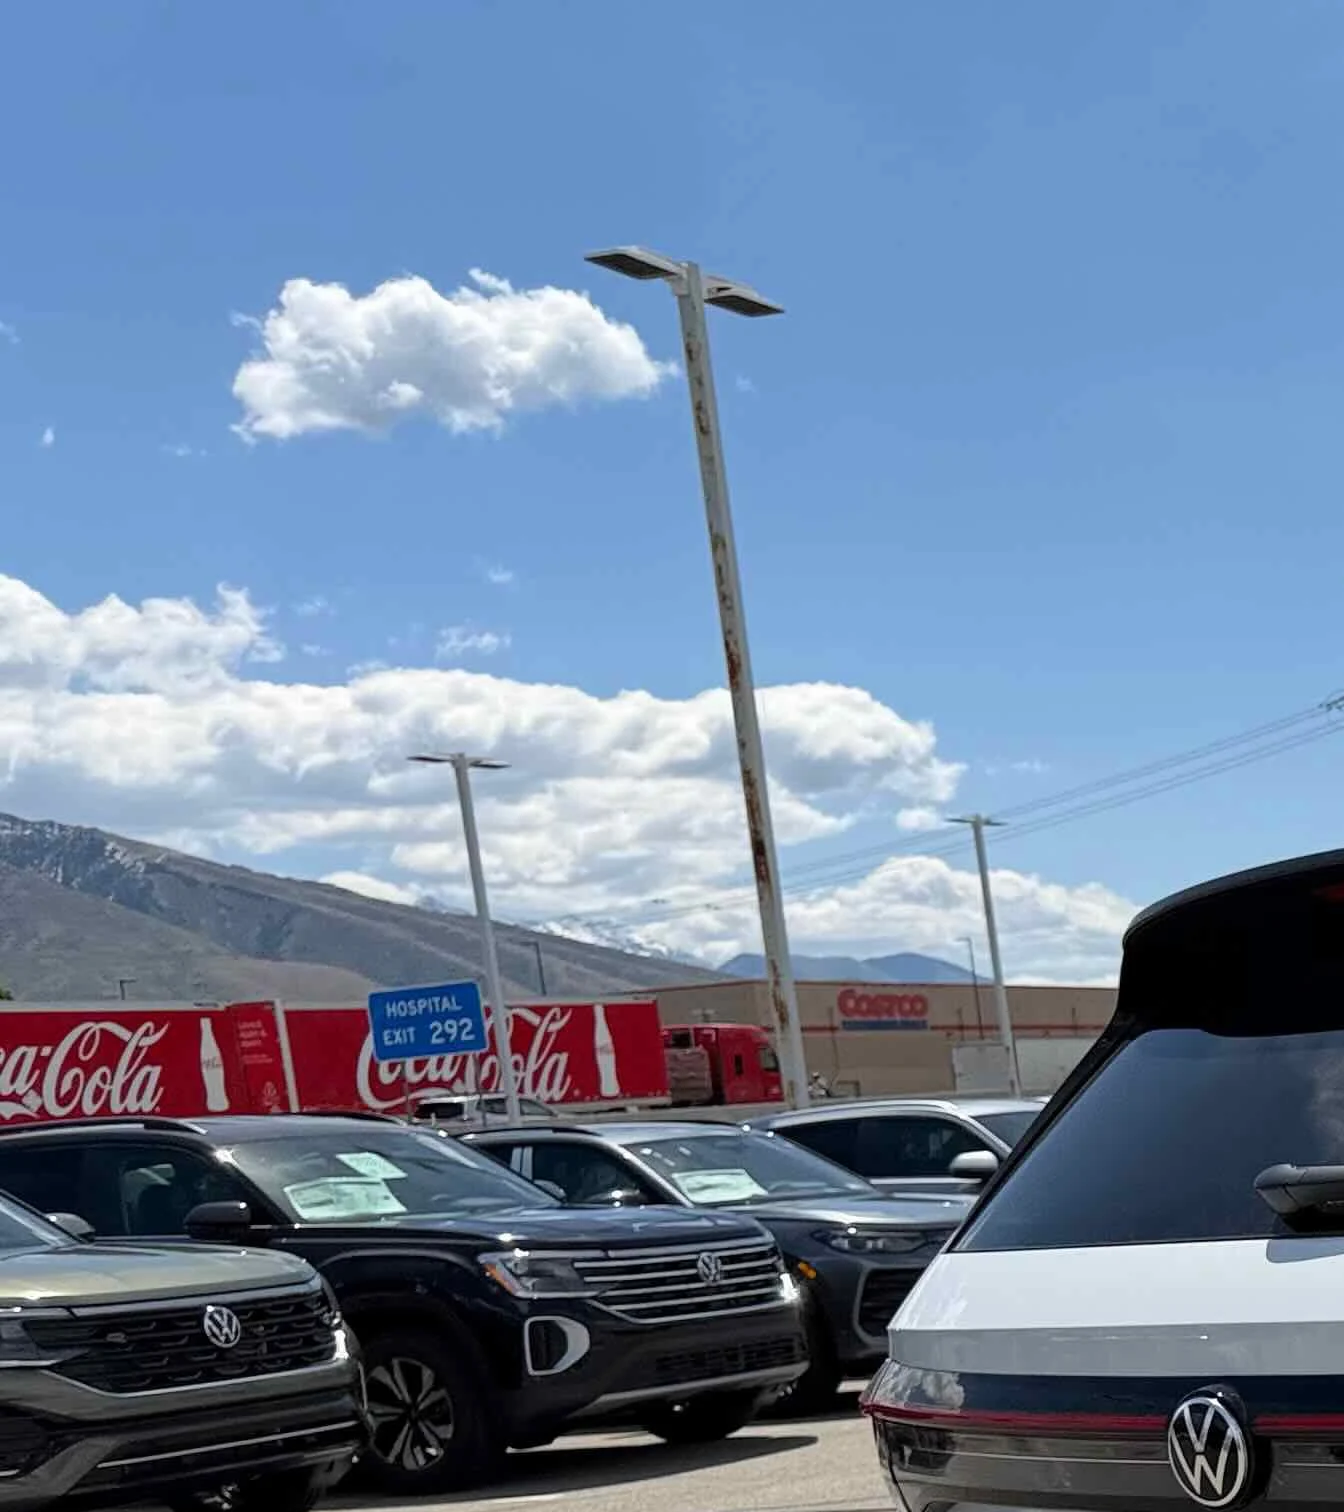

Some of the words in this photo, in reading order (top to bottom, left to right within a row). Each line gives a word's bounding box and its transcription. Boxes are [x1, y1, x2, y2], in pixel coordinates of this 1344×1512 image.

[385, 996, 463, 1018] HOSPITAL
[382, 1026, 416, 1047] EXIT
[429, 1018, 476, 1045] 292
[0, 1021, 170, 1119] a-Cola
